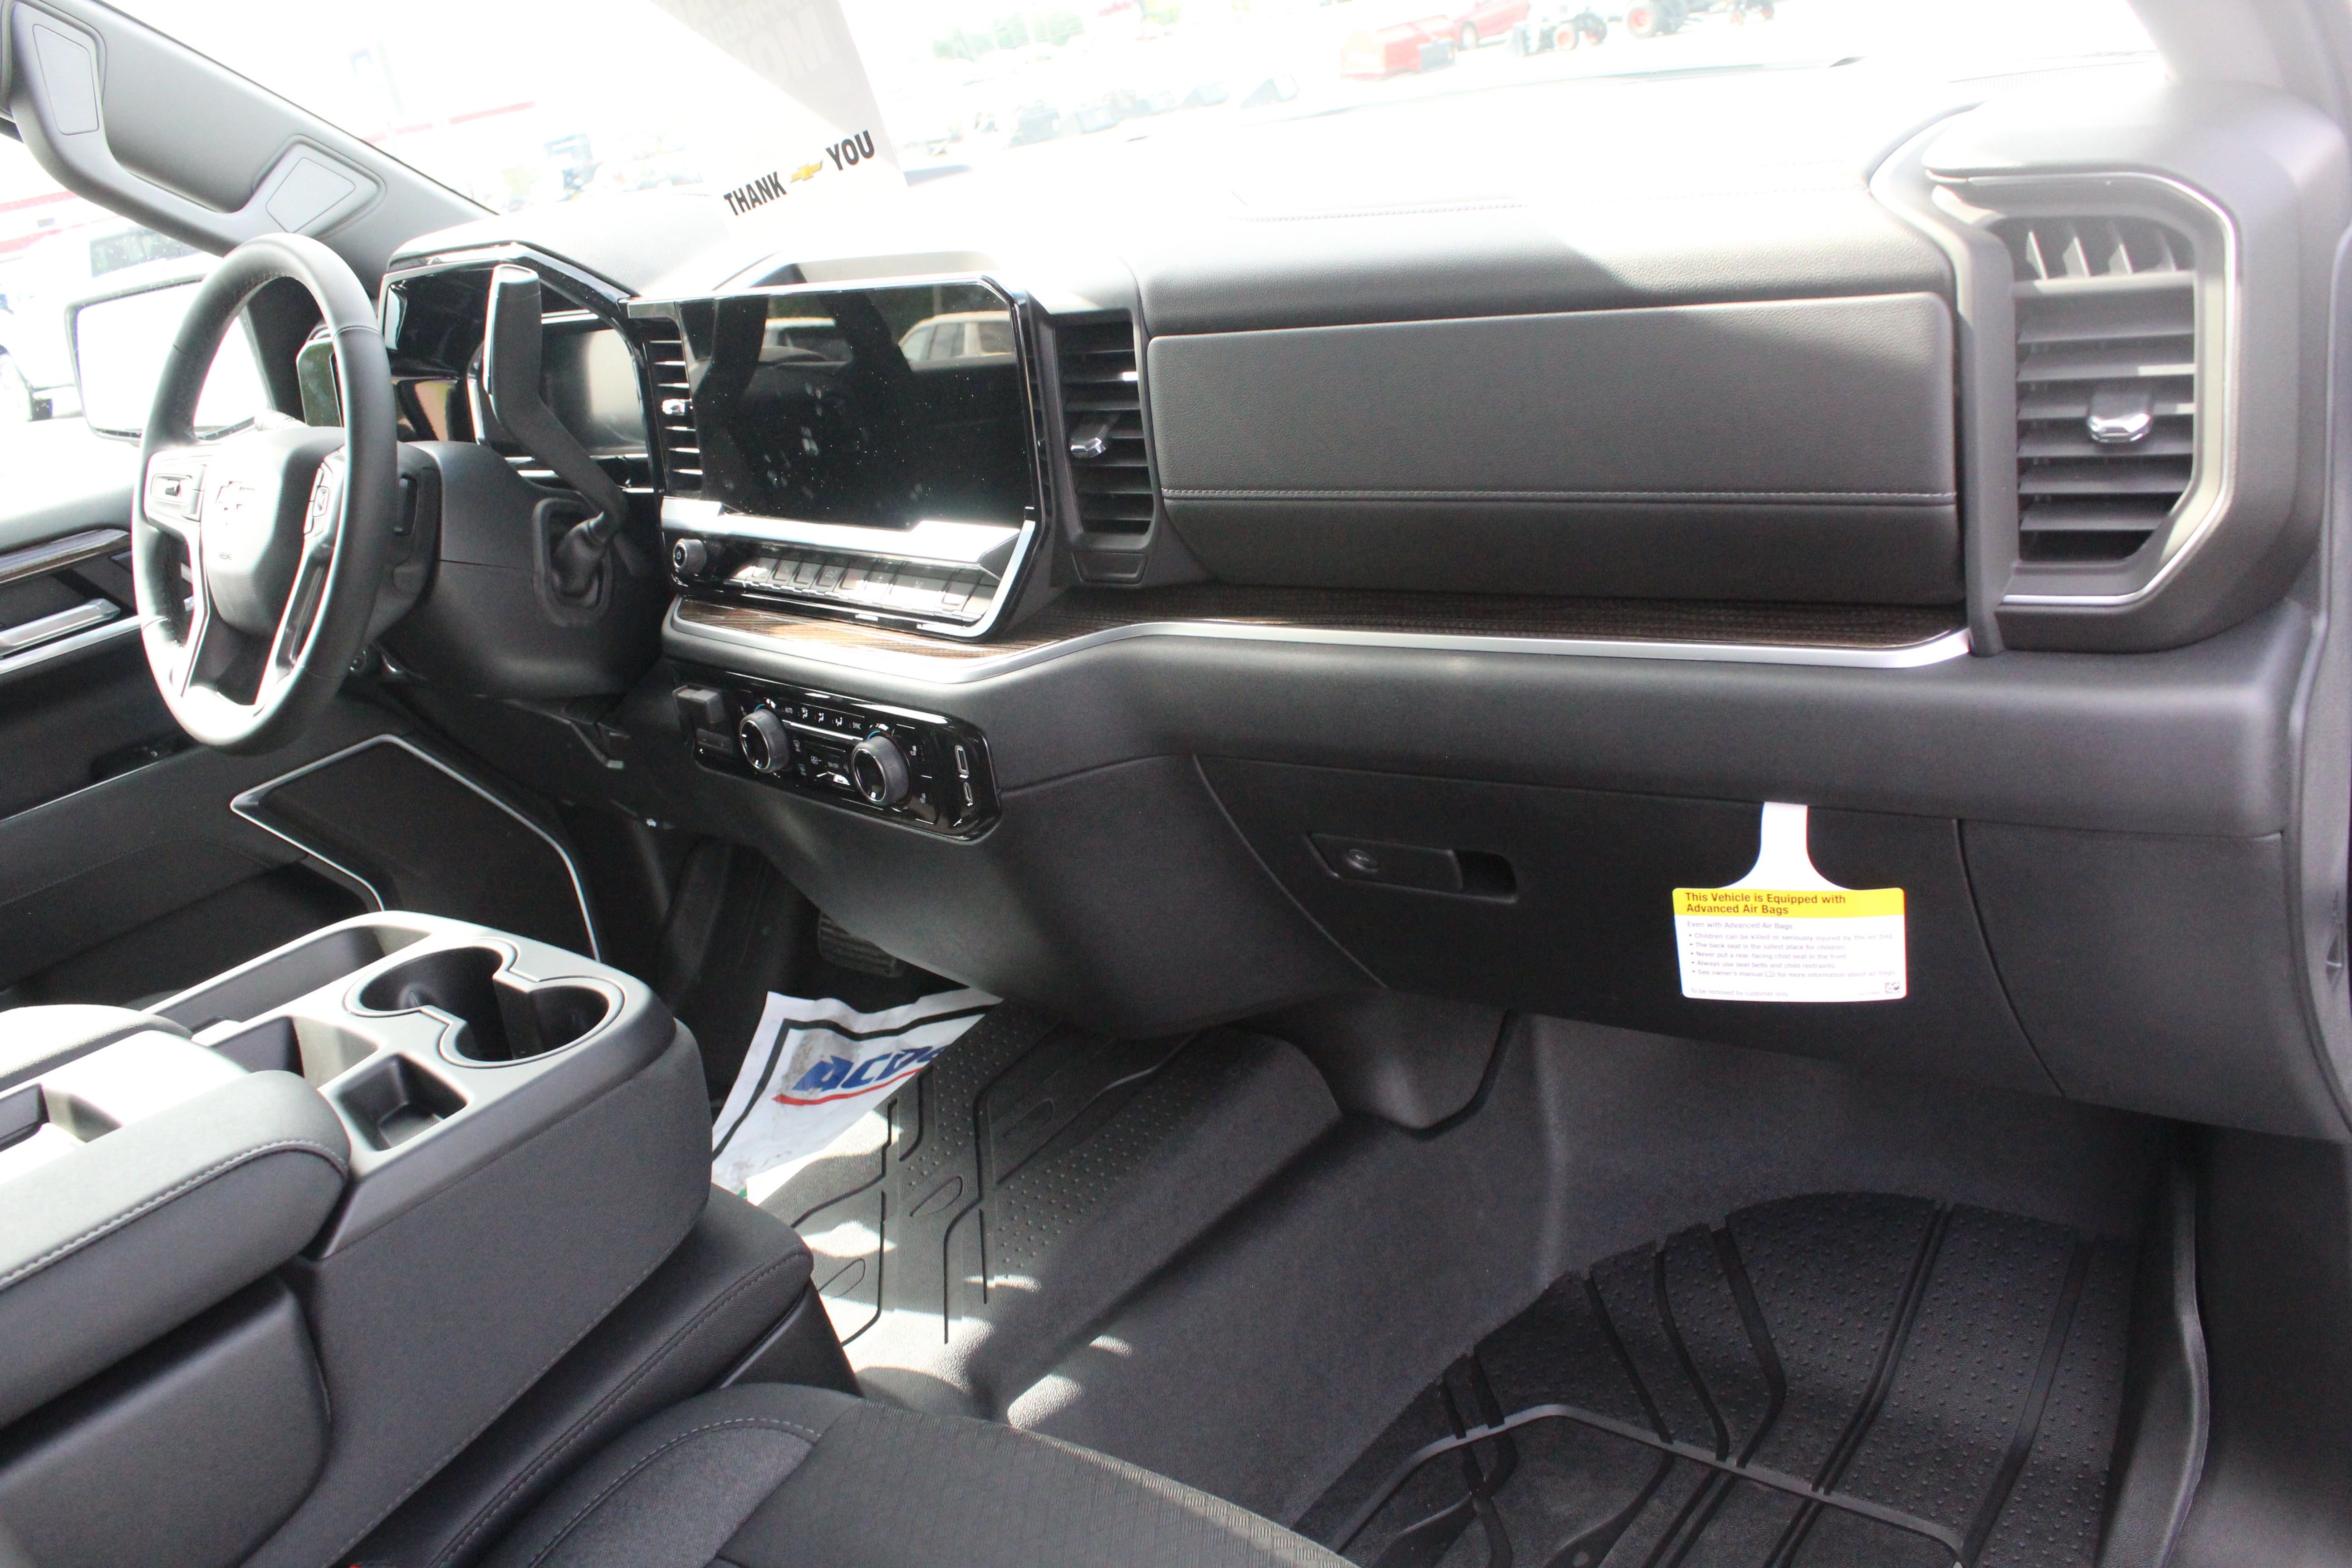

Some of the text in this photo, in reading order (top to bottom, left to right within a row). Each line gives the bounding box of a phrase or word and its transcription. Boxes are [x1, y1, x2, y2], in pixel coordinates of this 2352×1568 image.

[723, 130, 875, 216] THANK YOU
[1686, 893, 1846, 904] This Vehicle is Equipped with
[1687, 904, 1788, 916] Advanced Air Bags
